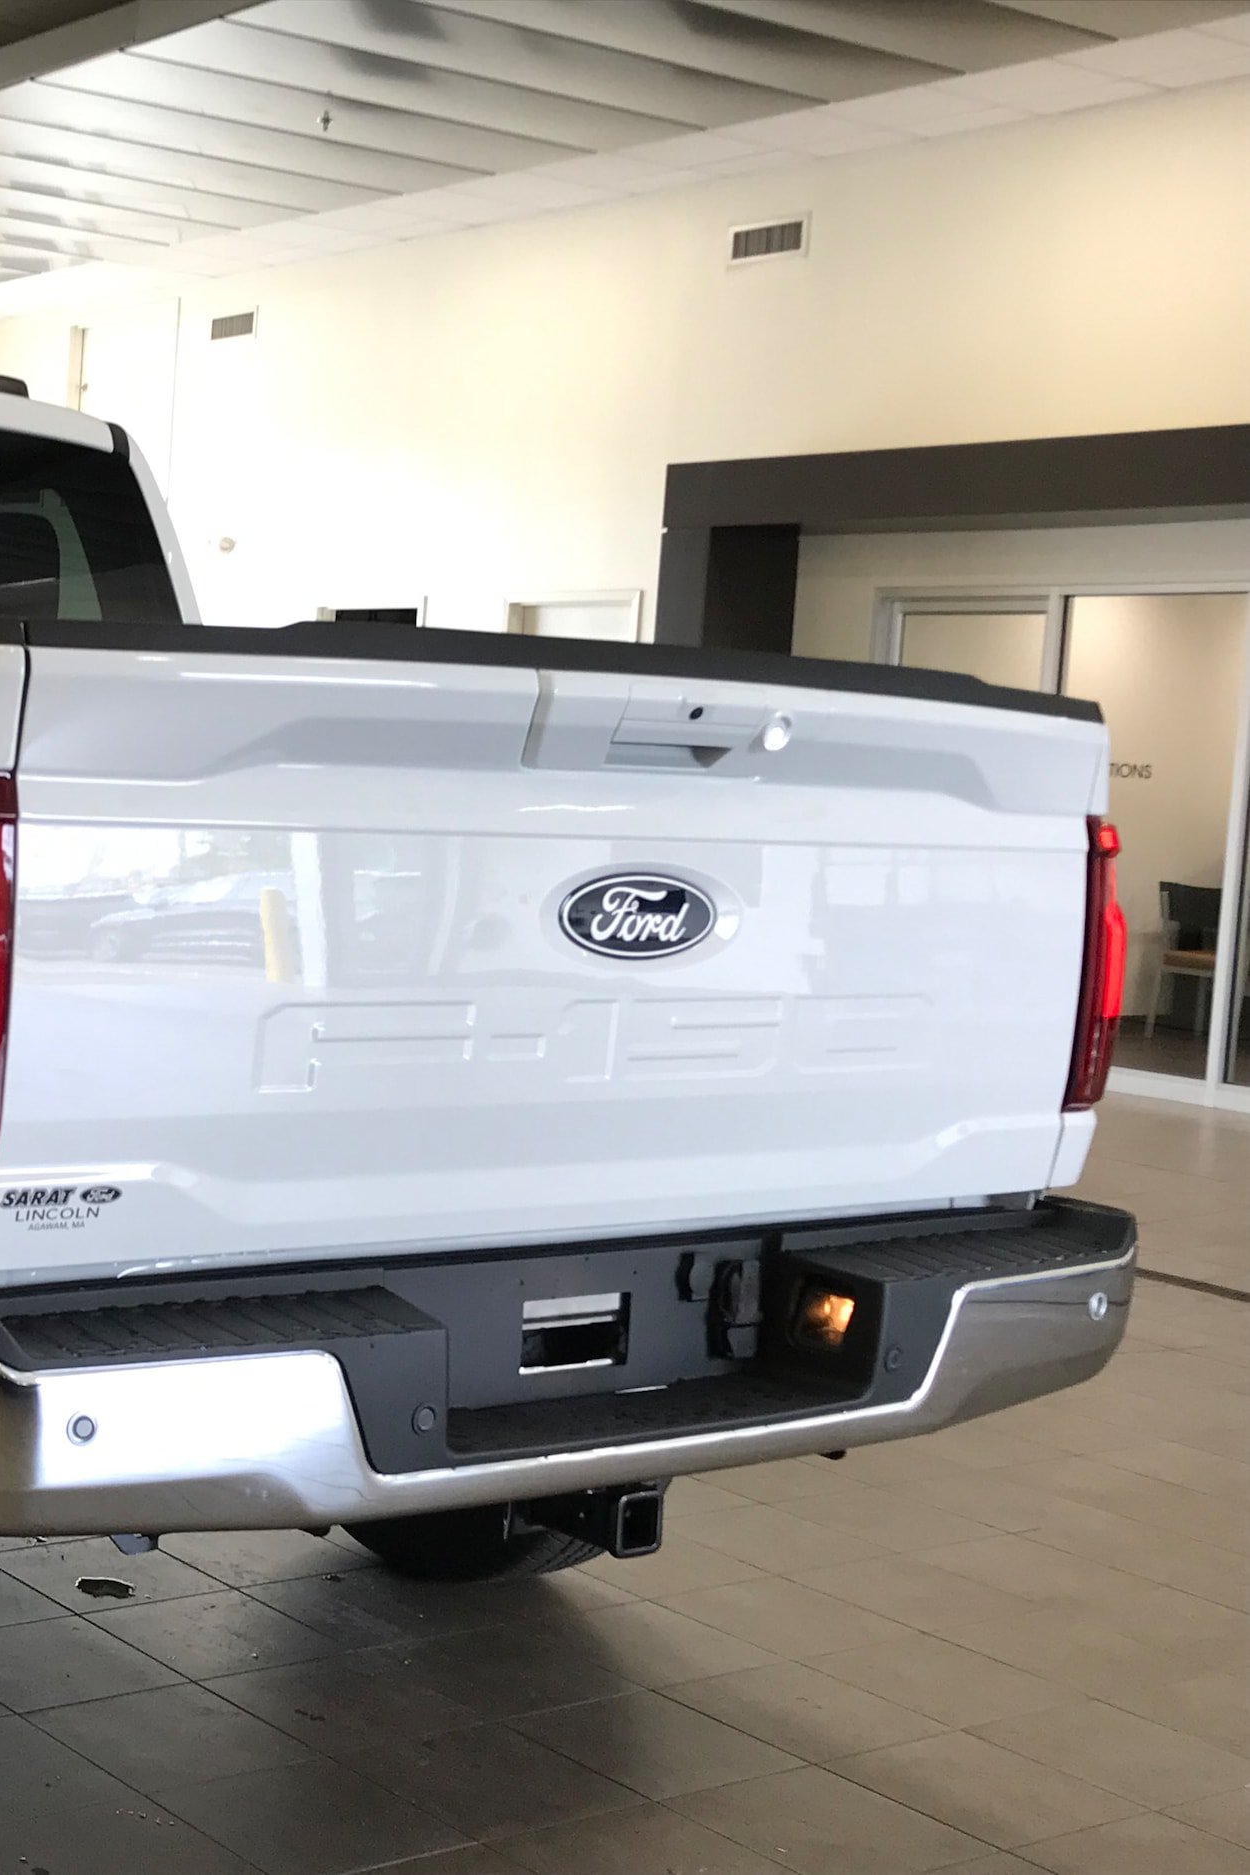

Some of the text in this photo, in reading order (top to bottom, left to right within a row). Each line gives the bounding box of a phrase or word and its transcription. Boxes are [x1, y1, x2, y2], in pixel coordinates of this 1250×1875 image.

[590, 886, 690, 943] Ford
[0, 1187, 77, 1209] SARAT
[15, 1206, 100, 1222] LINCOLN
